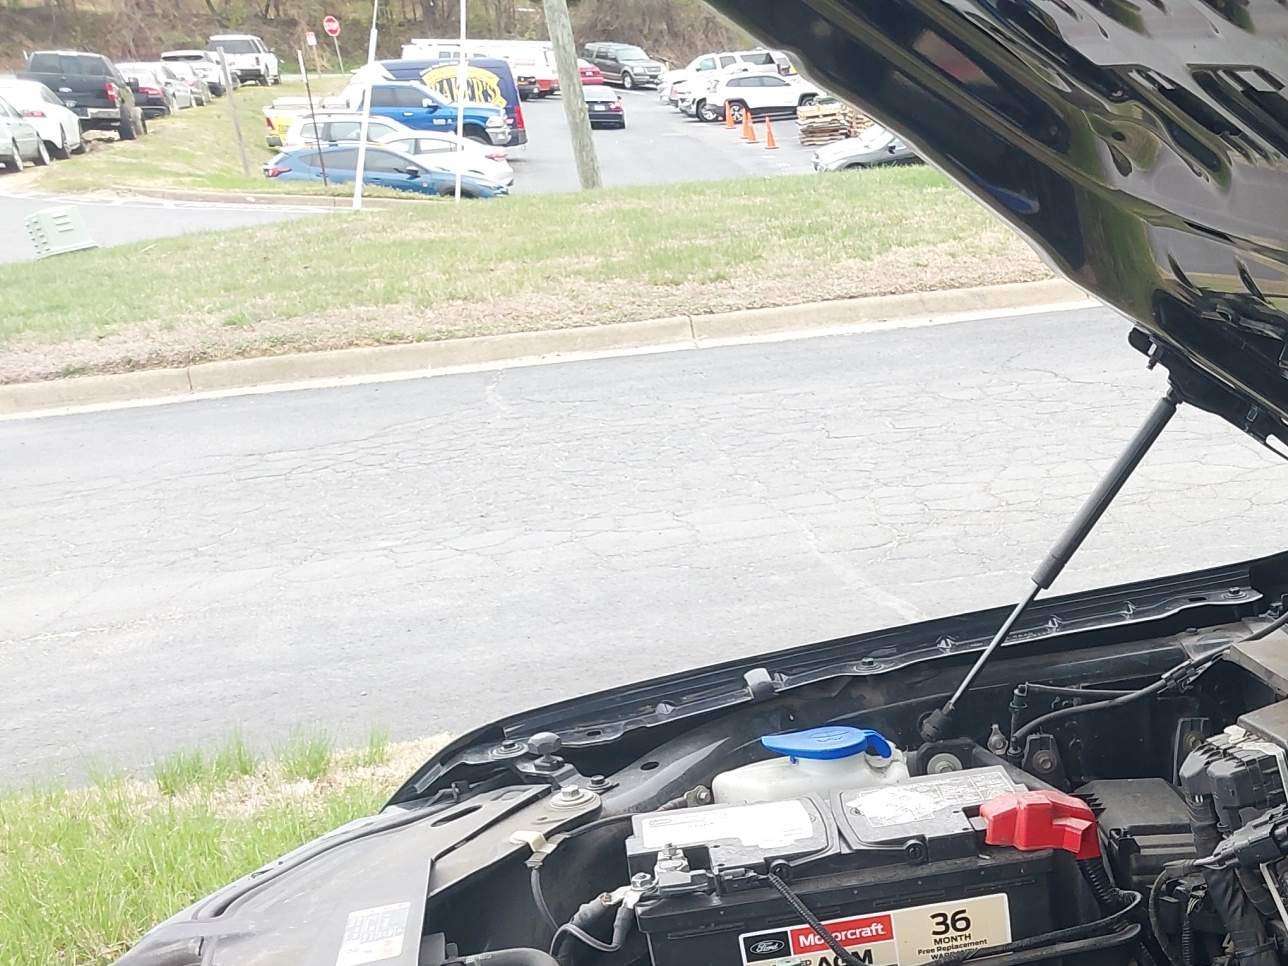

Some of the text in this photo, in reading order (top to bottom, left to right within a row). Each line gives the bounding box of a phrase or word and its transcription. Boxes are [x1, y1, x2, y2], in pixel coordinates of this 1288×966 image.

[930, 909, 971, 935] 36
[799, 923, 884, 947] Moorcraft
[934, 933, 971, 945] MONTH
[756, 942, 779, 953] Ford
[936, 939, 988, 952] Replacement
